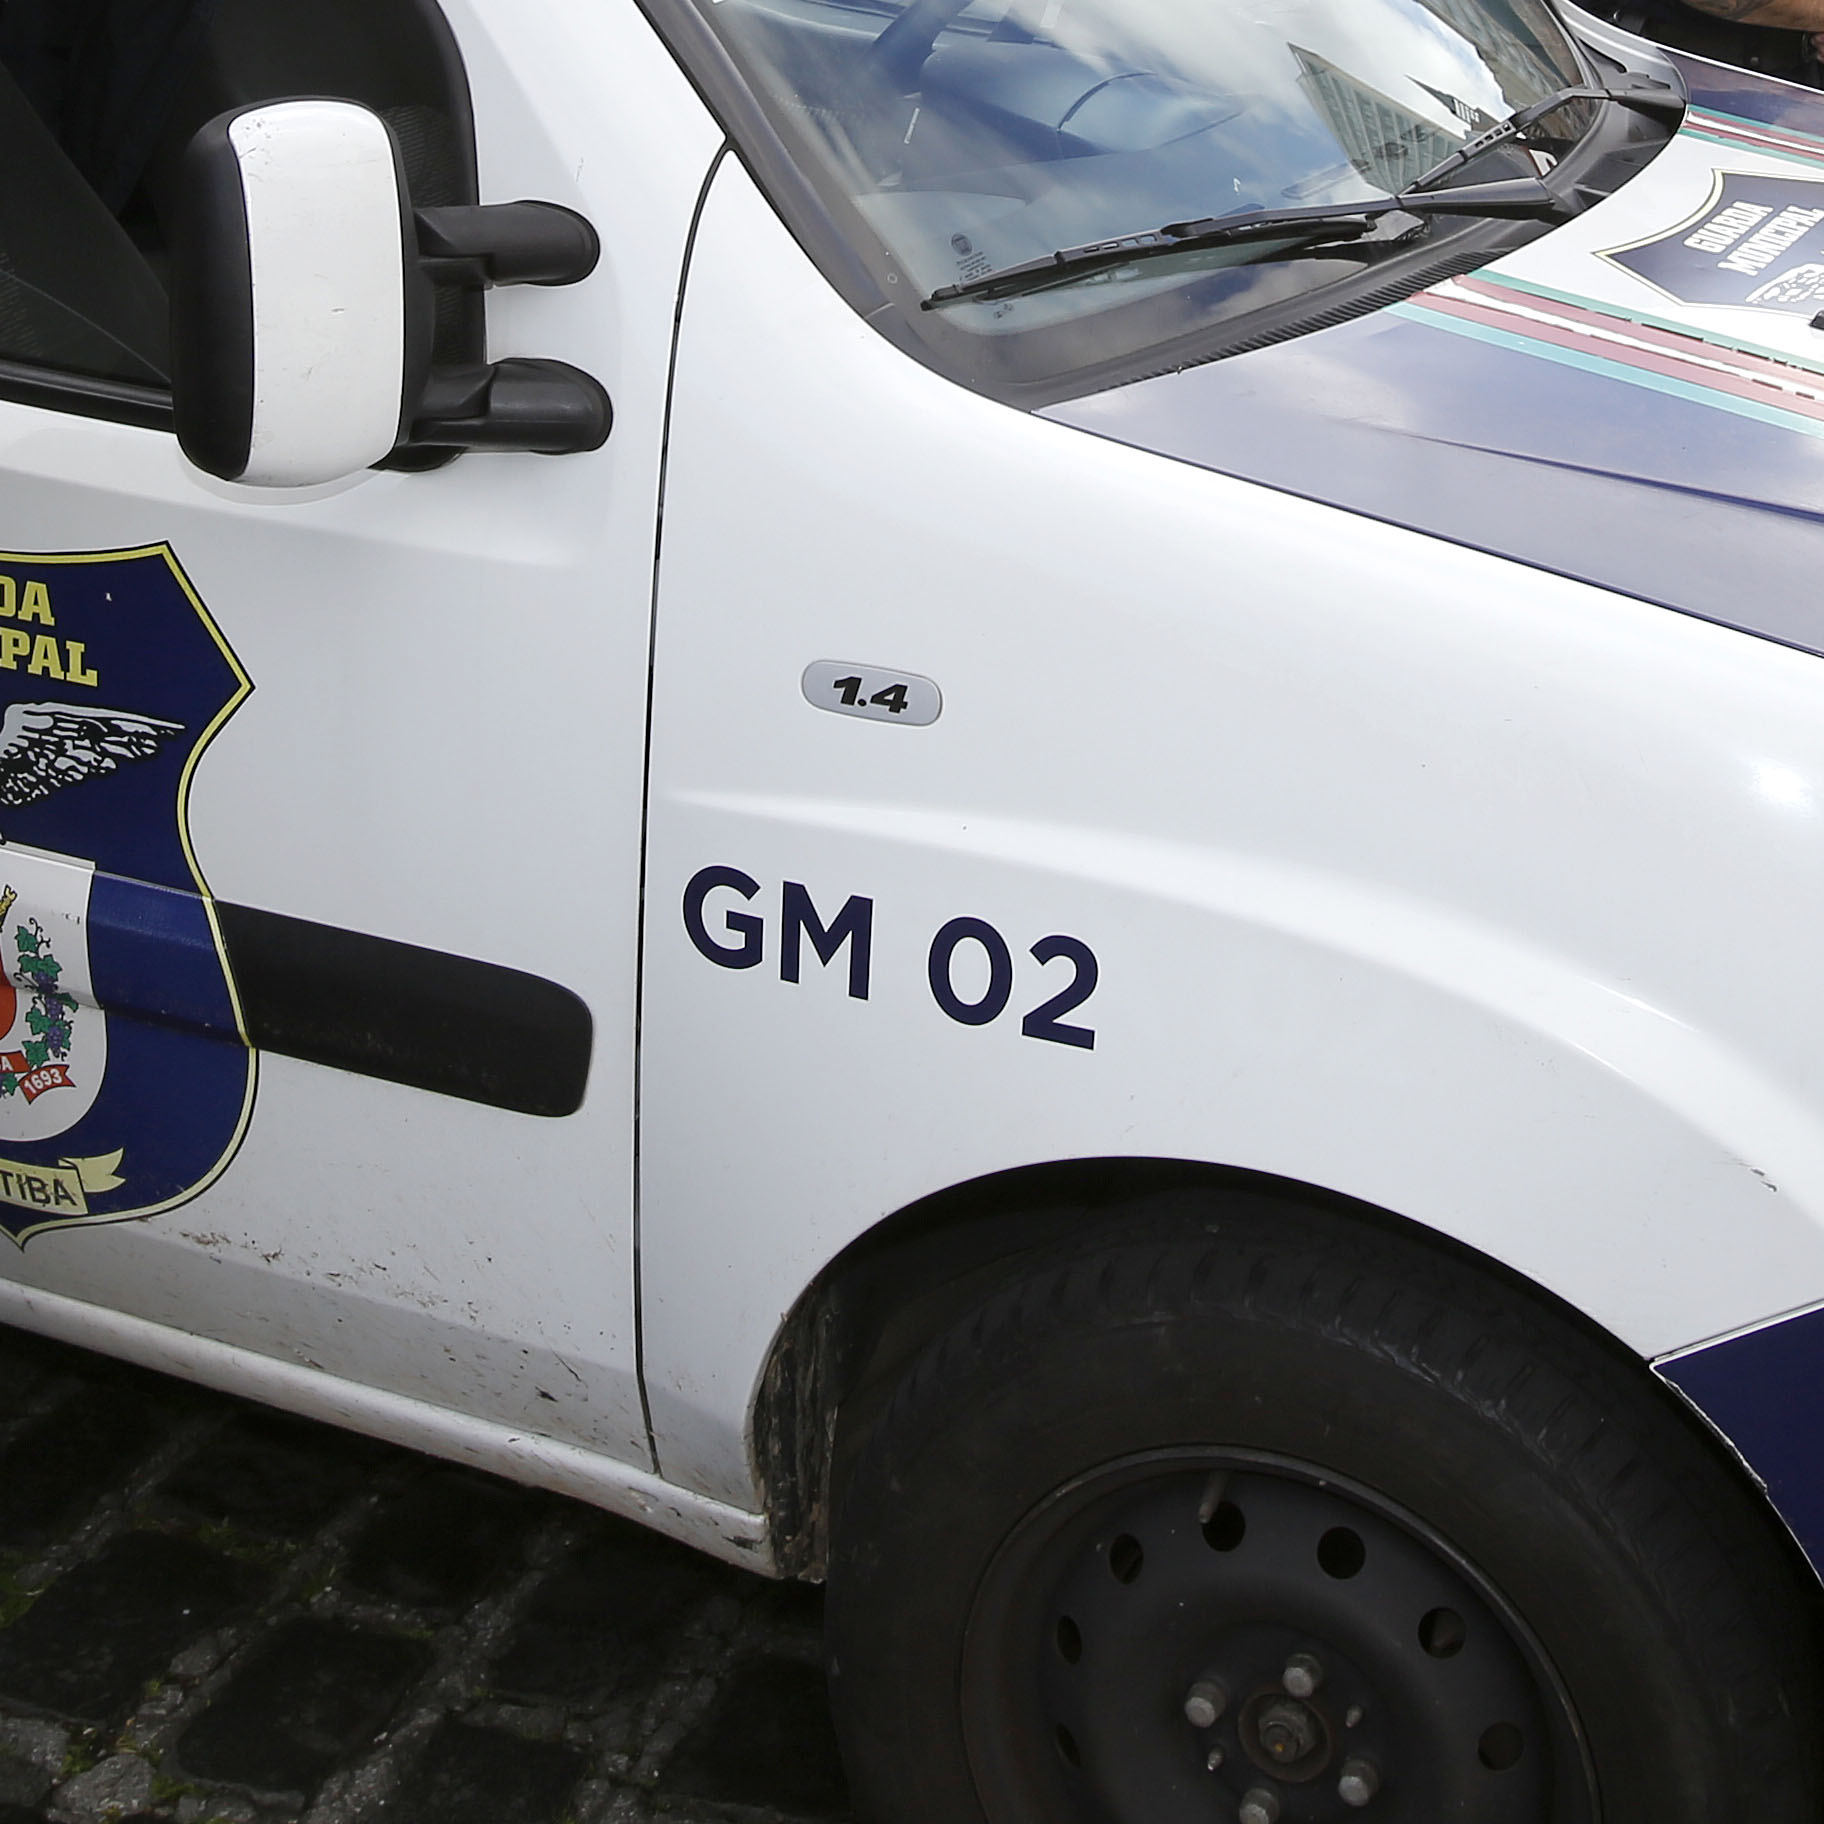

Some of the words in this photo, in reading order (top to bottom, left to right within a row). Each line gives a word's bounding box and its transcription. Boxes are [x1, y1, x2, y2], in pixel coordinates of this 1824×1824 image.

[1683, 200, 1775, 254] GUARDA
[831, 675, 909, 714] 1.4
[681, 864, 874, 1001] GM
[927, 916, 1099, 1051] 02
[23, 1067, 64, 1095] 1693
